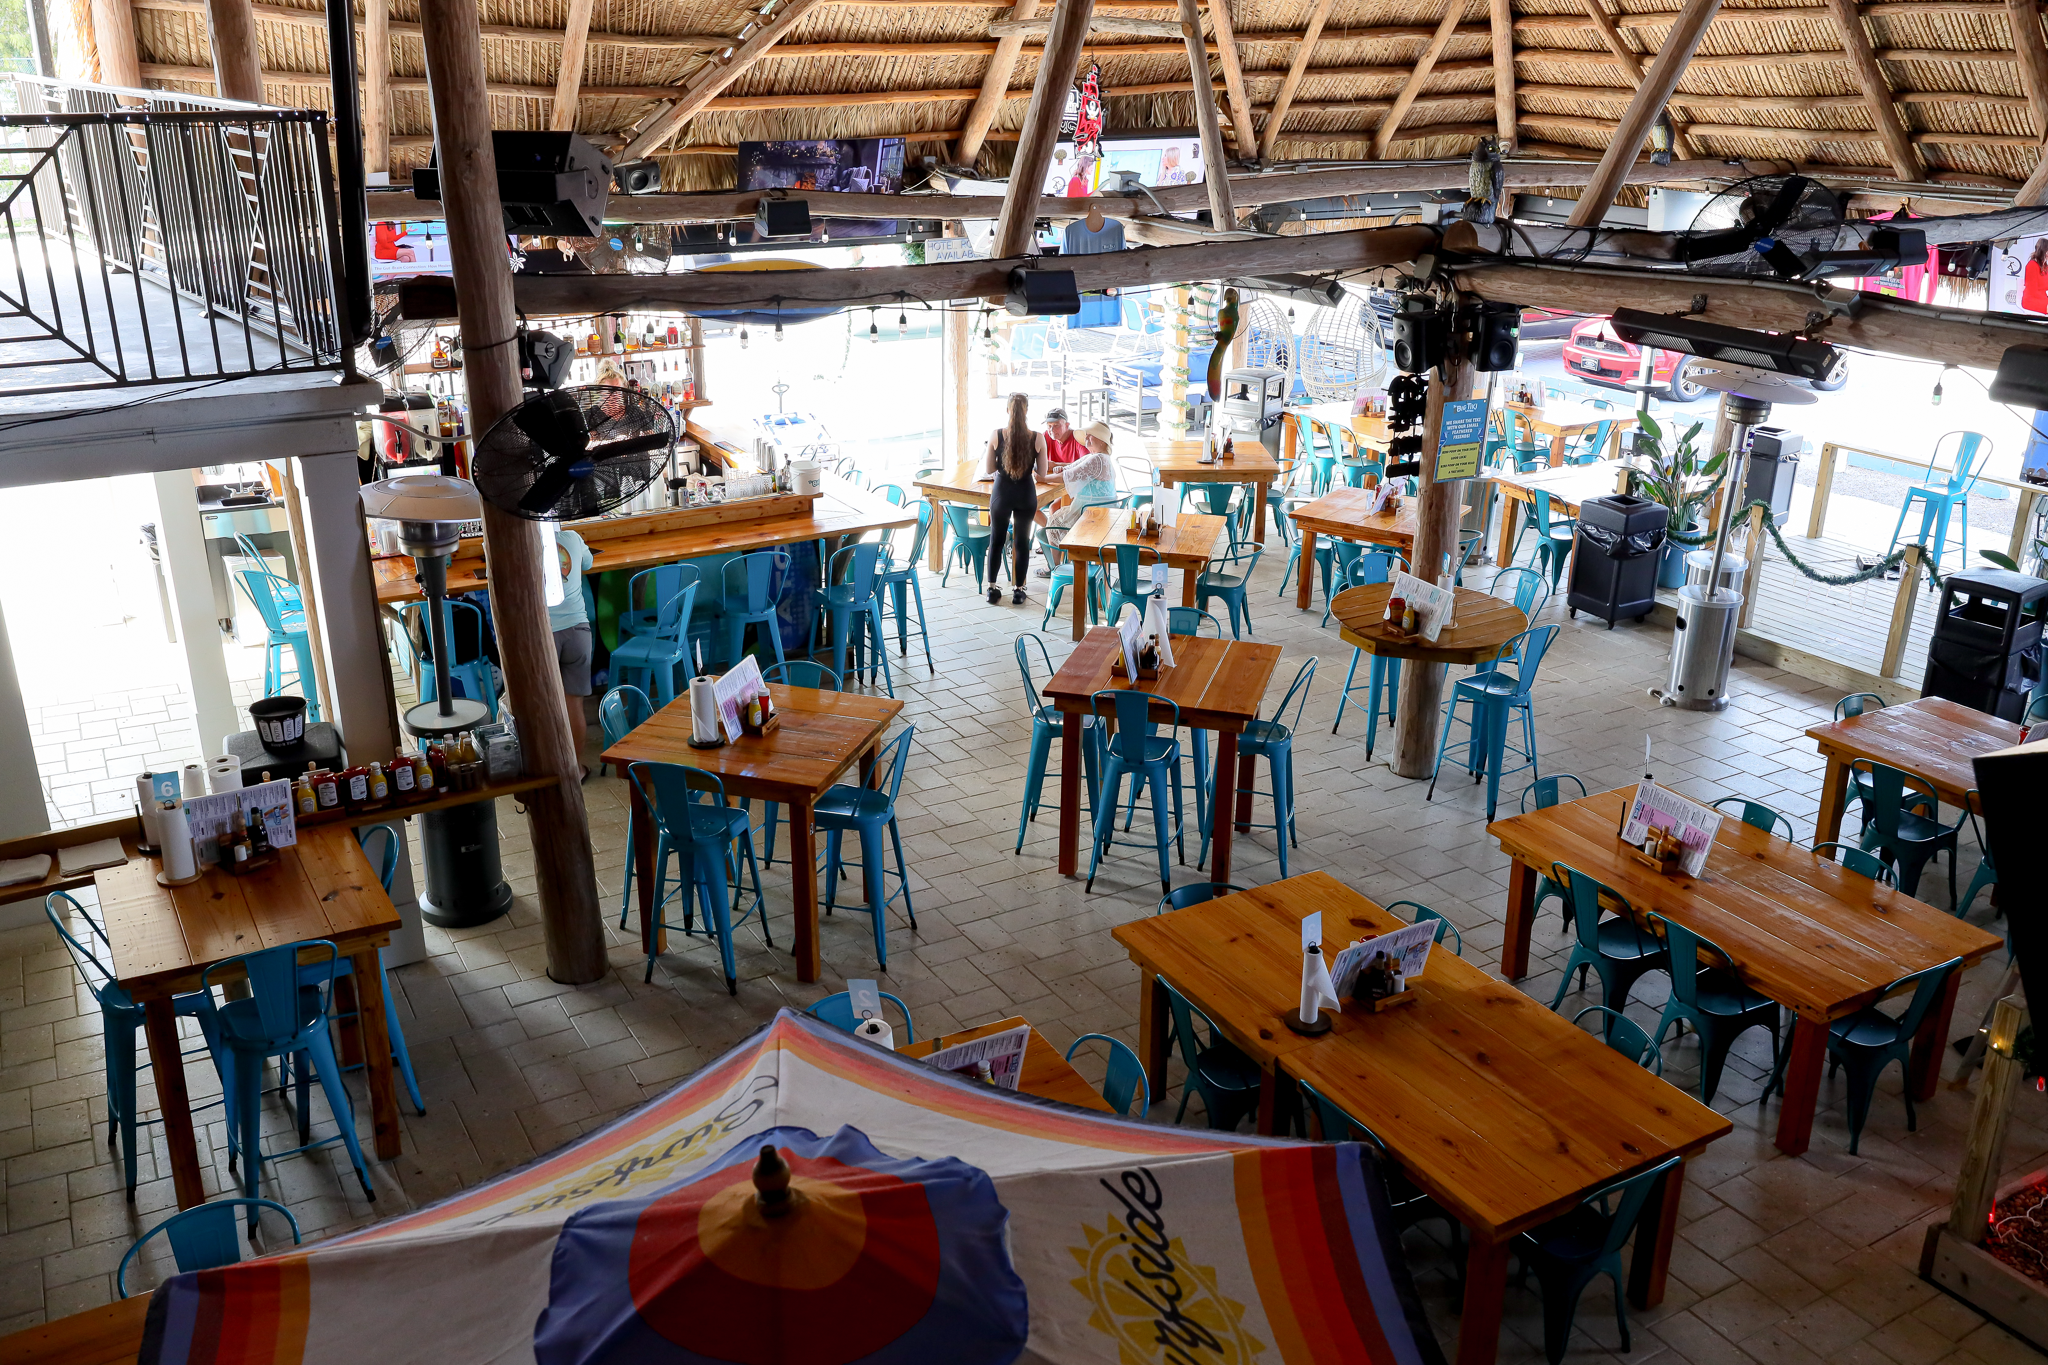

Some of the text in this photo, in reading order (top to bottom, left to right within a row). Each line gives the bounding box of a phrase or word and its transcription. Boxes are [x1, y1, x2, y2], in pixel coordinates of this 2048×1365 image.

[928, 242, 958, 252] HOTEL
[1156, 570, 1164, 582] 8
[160, 781, 174, 797] 6
